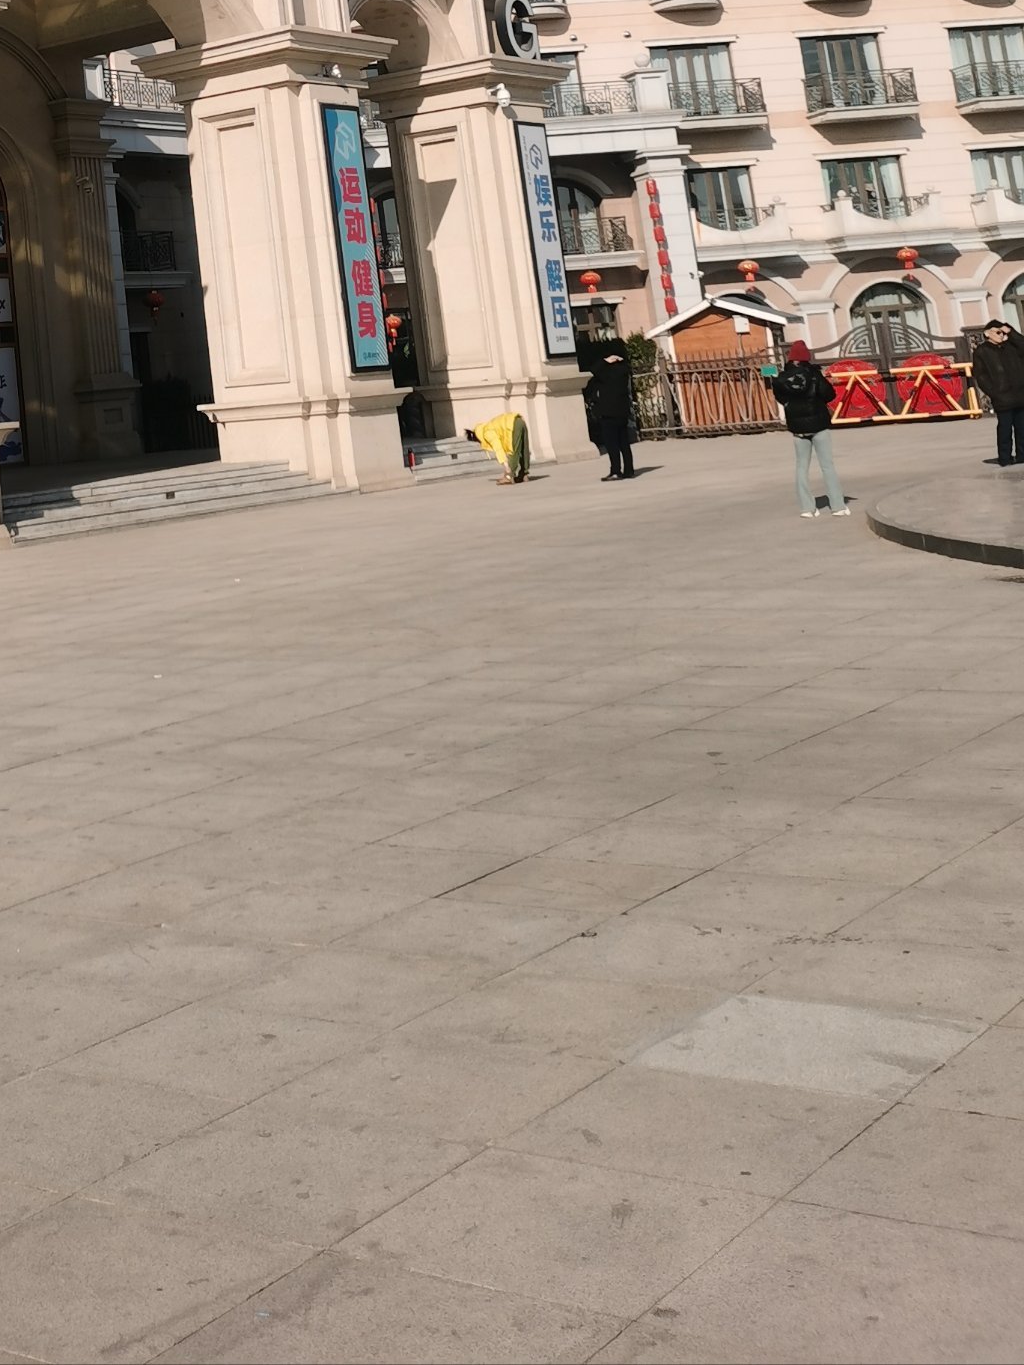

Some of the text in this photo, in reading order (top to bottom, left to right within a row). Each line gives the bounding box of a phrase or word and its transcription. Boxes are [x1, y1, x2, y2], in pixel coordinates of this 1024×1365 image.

[338, 167, 368, 245] 运动
[534, 174, 558, 243] 娱乐
[351, 259, 378, 338] 健身
[545, 258, 570, 329] 解压
